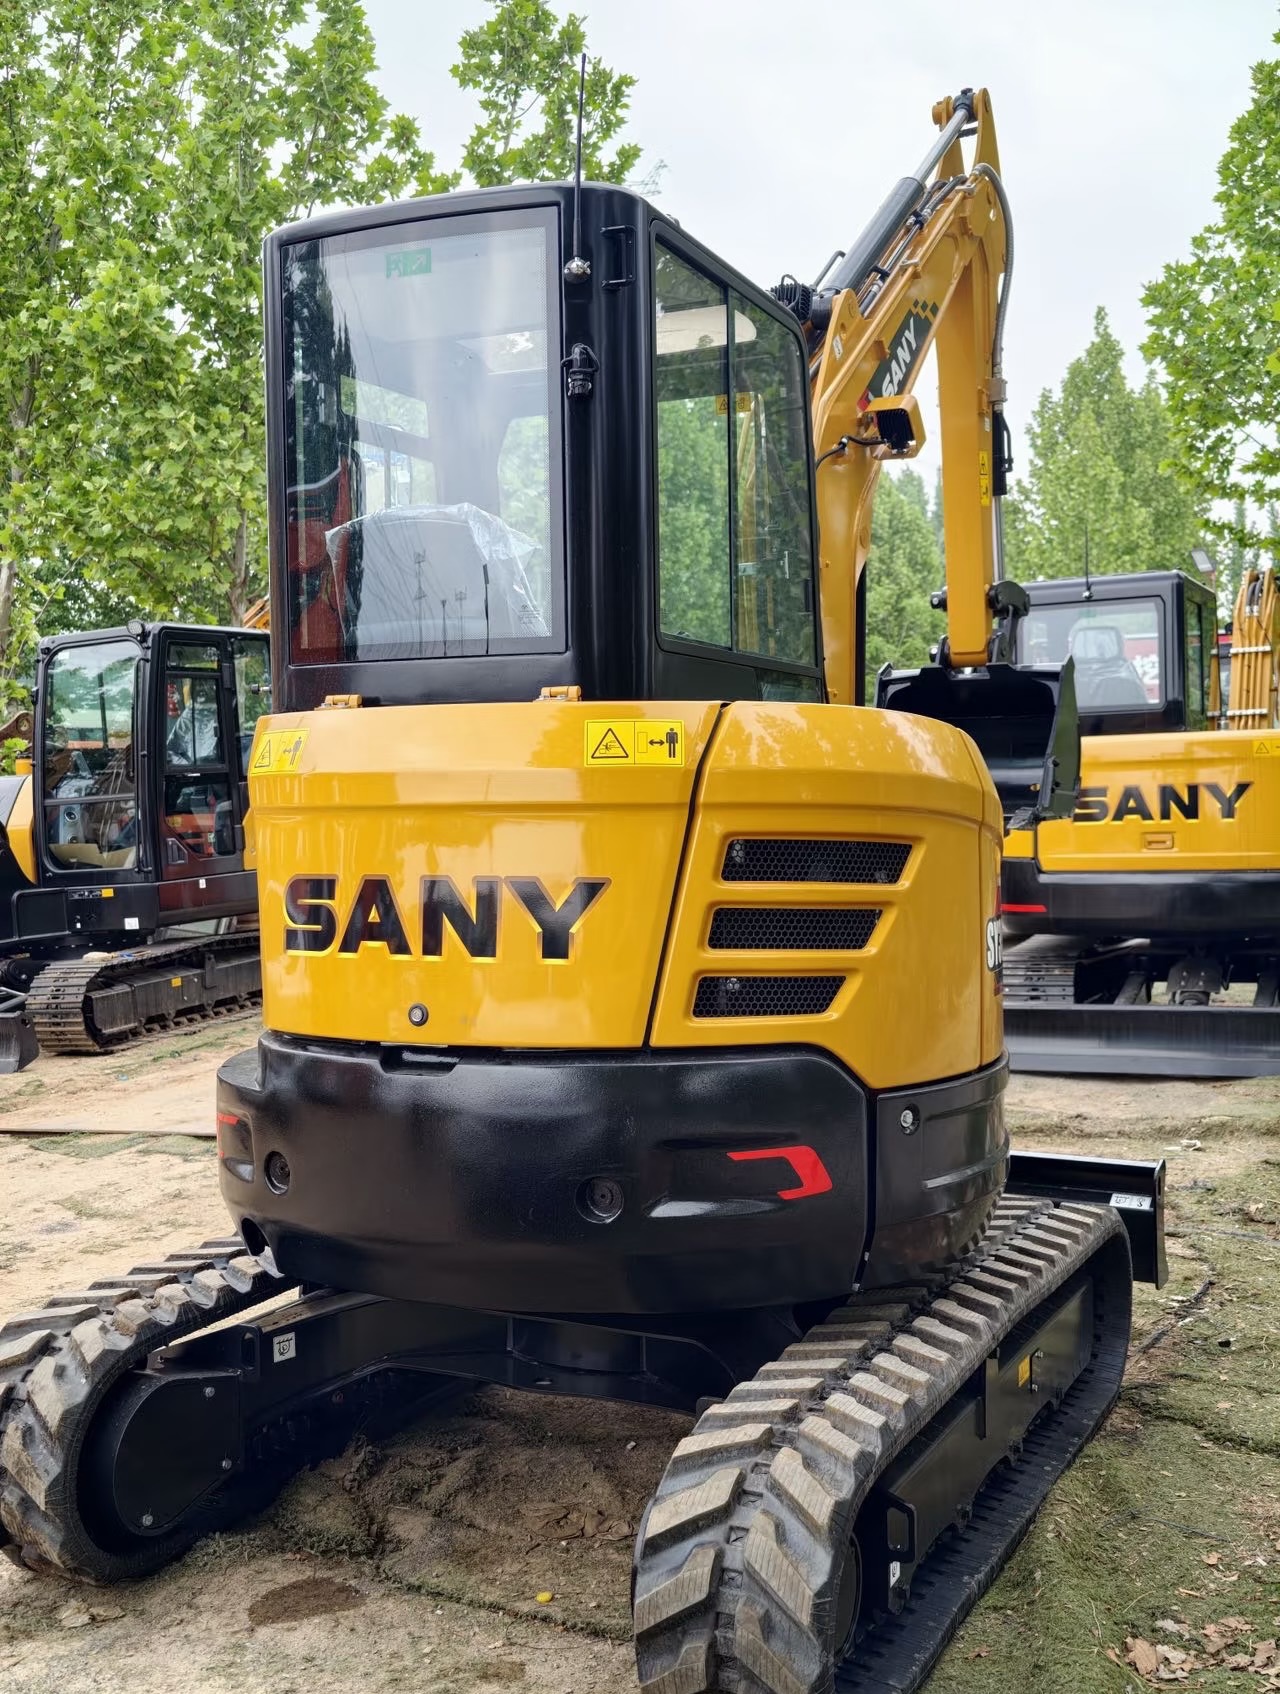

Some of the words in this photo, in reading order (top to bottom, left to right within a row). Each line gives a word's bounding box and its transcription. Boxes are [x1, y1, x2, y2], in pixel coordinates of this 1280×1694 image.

[882, 316, 917, 398] SANY
[1072, 782, 1253, 823] SANY
[284, 875, 611, 963] SANY
